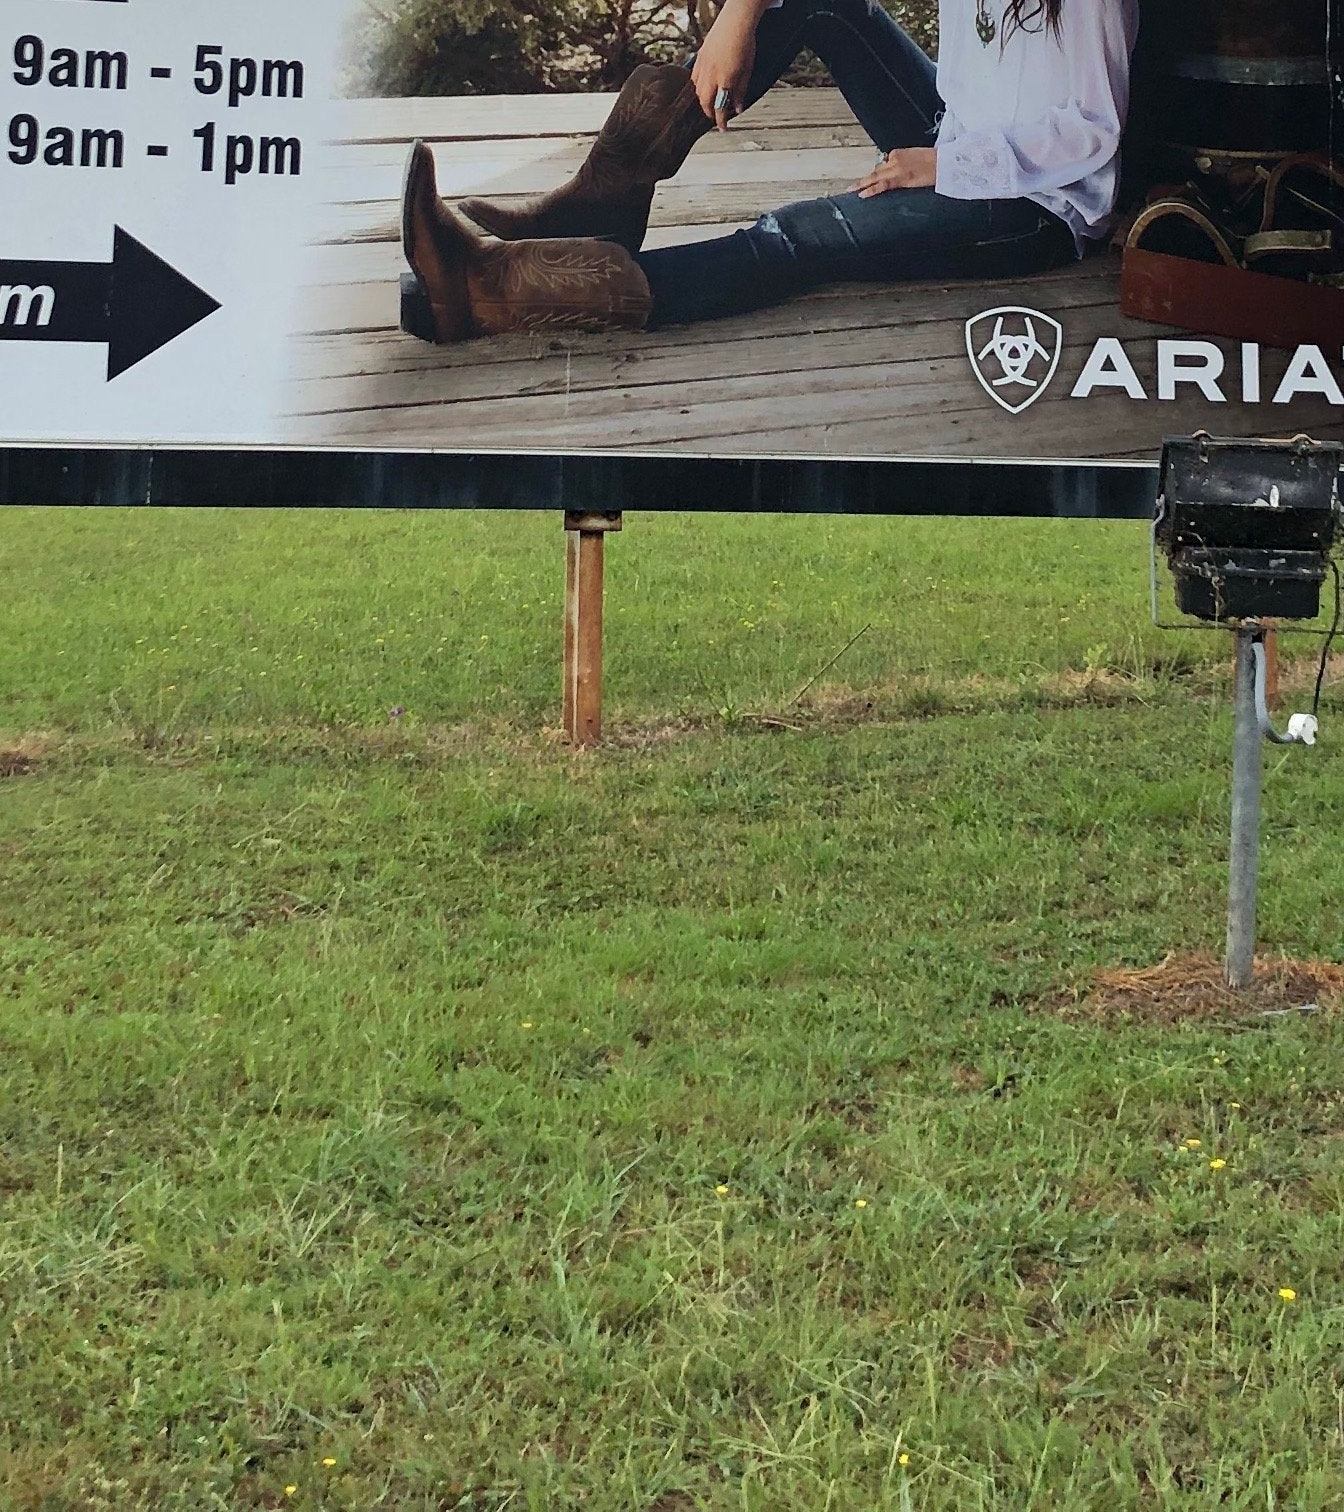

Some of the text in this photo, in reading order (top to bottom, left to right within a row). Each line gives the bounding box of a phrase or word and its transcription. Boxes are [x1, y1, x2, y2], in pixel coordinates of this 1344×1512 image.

[13, 34, 128, 90] 9am
[150, 67, 172, 79] -
[193, 44, 304, 108] 5pm
[7, 113, 124, 168] 9am
[146, 144, 169, 157] -
[193, 121, 301, 185] 1pm
